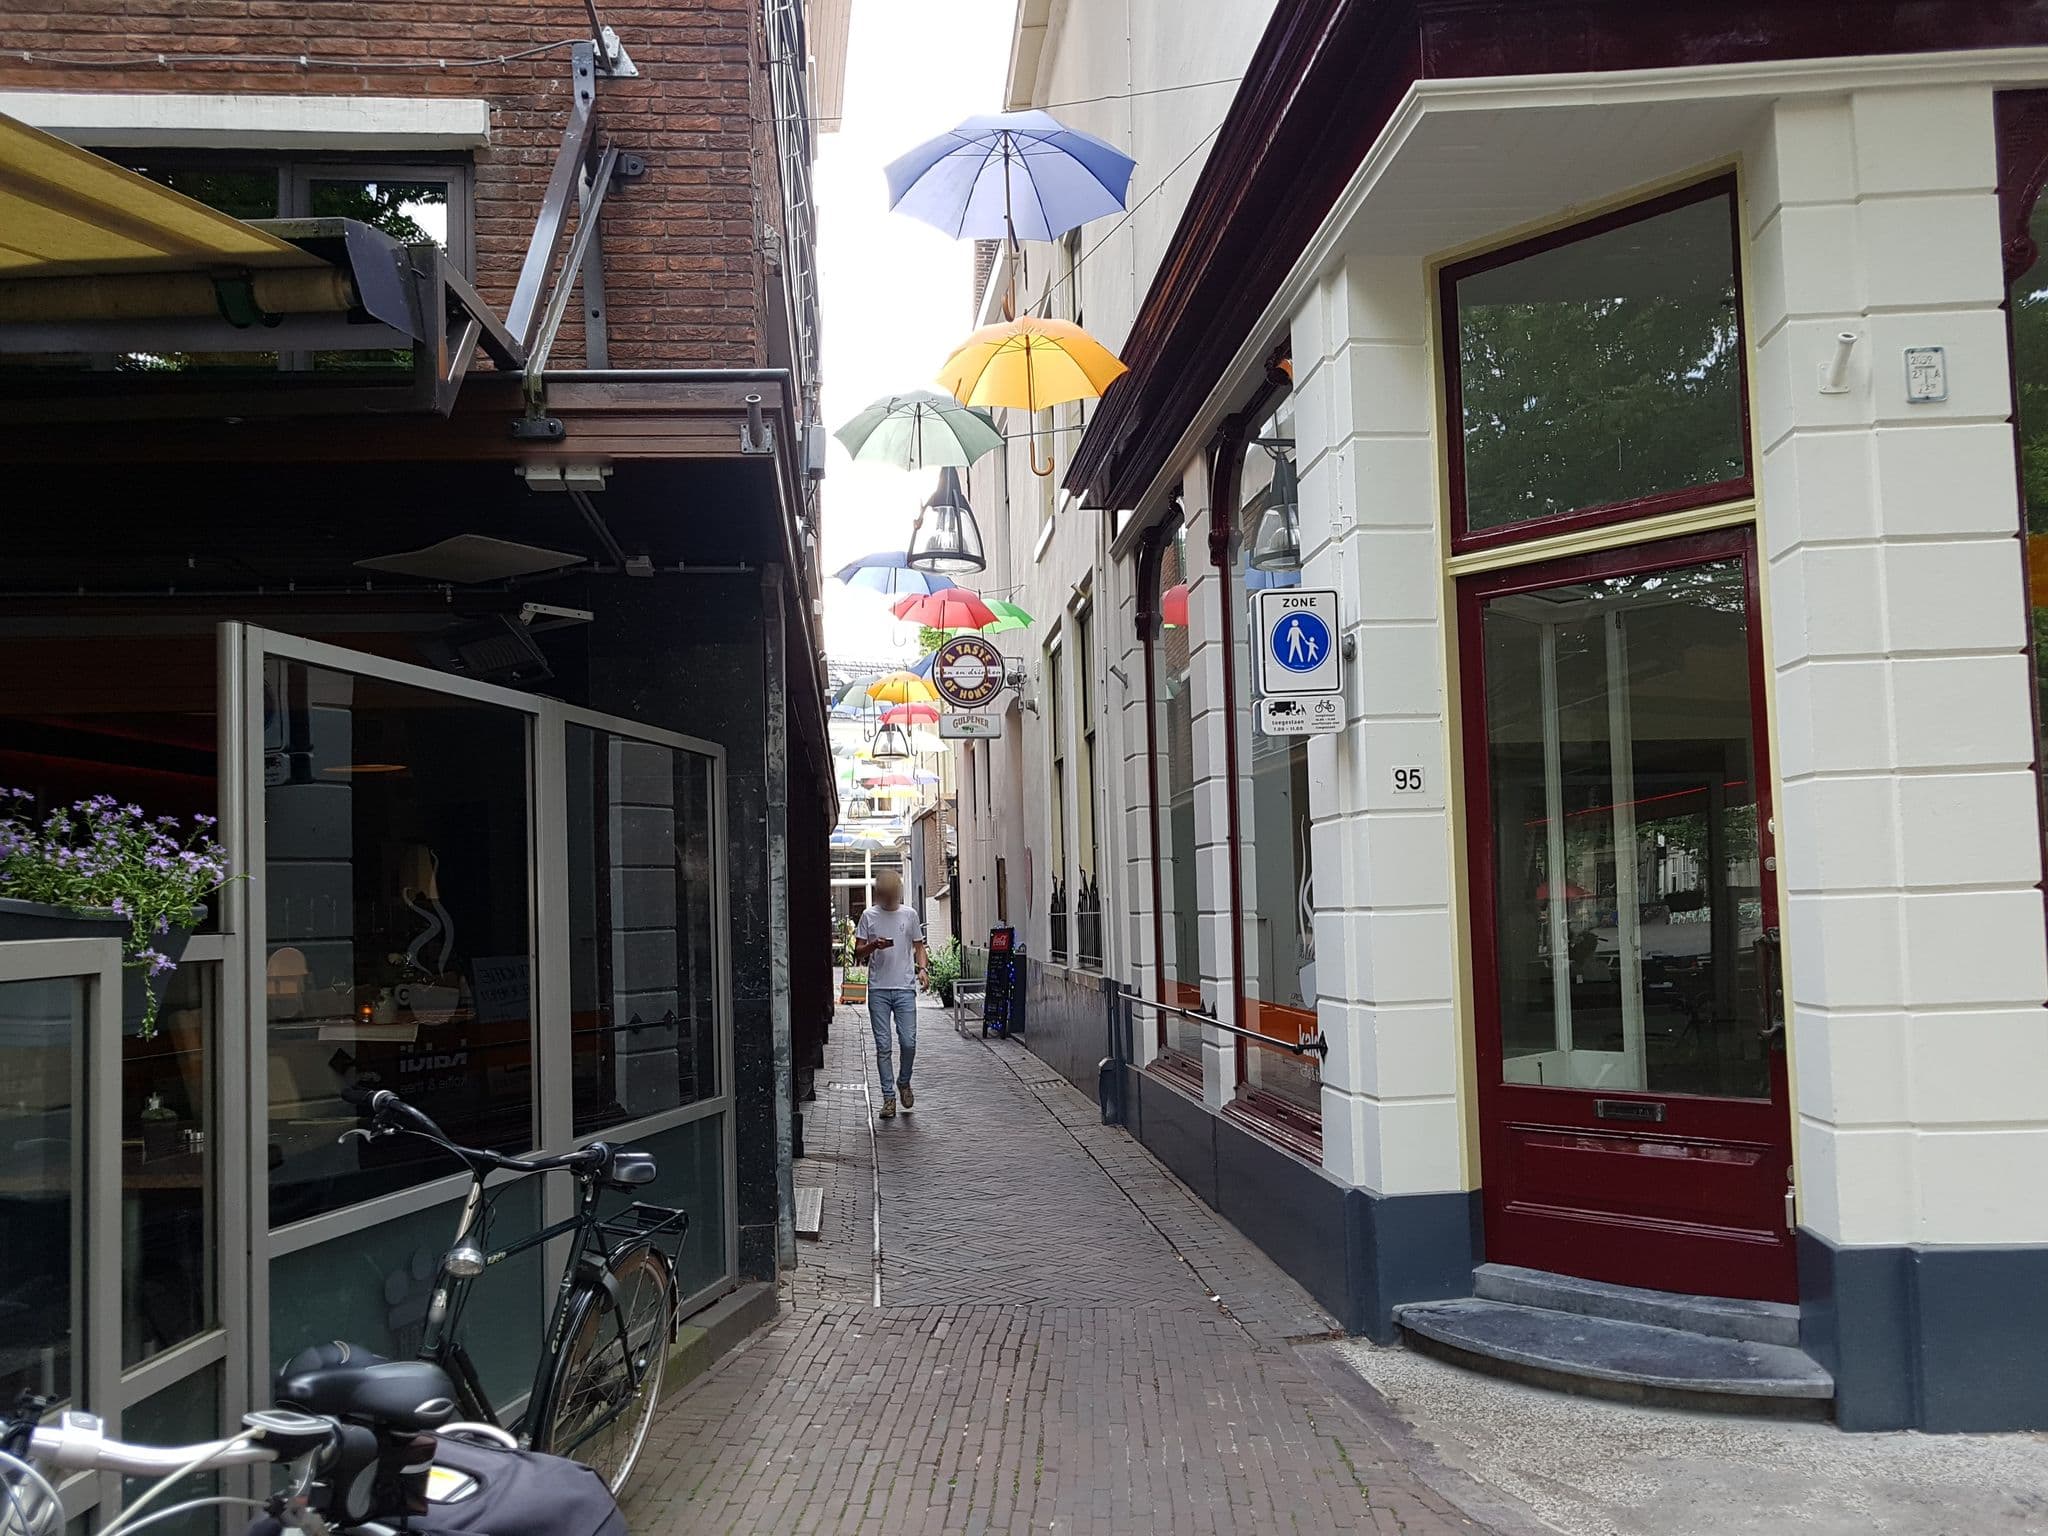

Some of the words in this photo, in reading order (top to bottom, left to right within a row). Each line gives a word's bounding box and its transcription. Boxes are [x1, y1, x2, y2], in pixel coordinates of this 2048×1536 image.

[1282, 597, 1317, 608] ZONE
[945, 653, 955, 664] A
[956, 644, 992, 662] TASTE
[945, 680, 958, 692] OF
[959, 681, 993, 699] HONEY
[953, 716, 989, 729] GULPENER
[1395, 768, 1422, 790] 95
